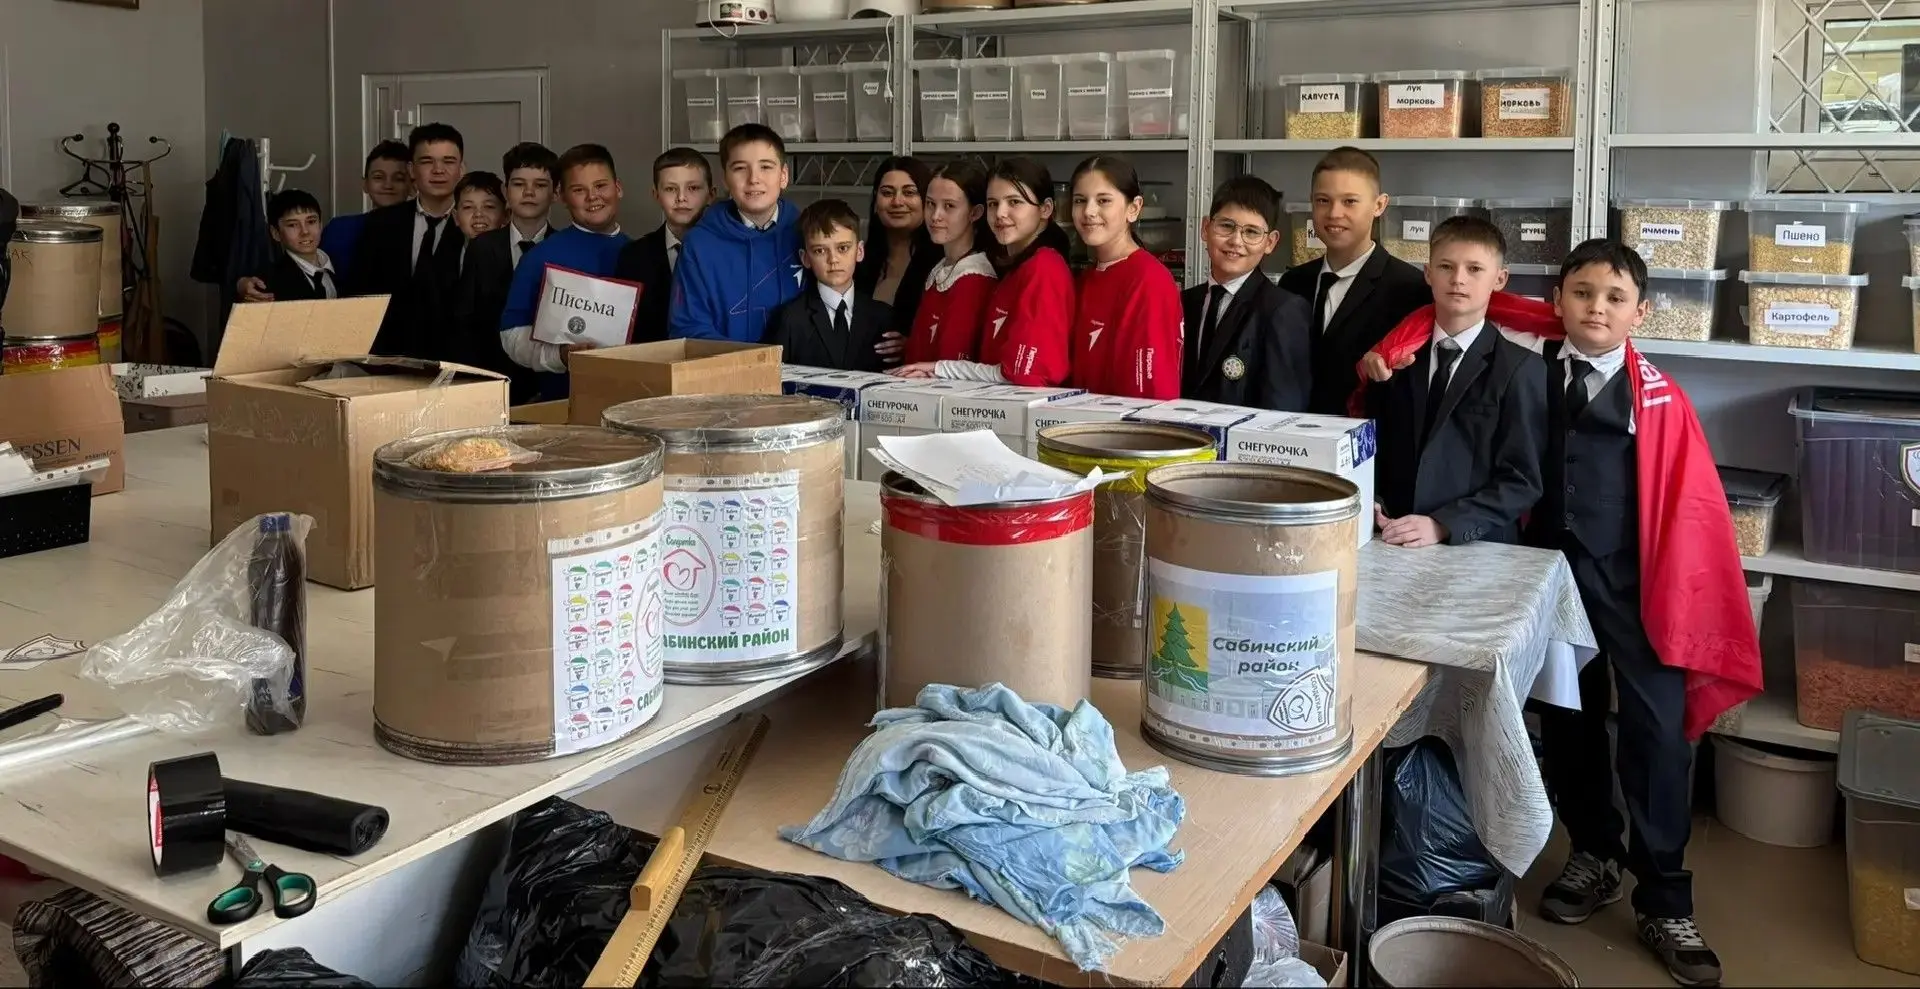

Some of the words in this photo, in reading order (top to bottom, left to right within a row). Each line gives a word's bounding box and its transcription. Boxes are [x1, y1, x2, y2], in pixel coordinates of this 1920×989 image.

[1301, 92, 1340, 101] КАПУСТА
[1396, 97, 1436, 105] морковь
[1641, 227, 1681, 236] ячмень
[1782, 229, 1820, 241] Пшено
[552, 286, 615, 317] Письма
[1771, 311, 1830, 323] Картофель
[867, 399, 919, 412] СНЕГУРОЧКА
[951, 406, 1007, 420] СНЕГУРОЧКА
[1238, 440, 1309, 458] СНЕГУРОЧКА
[742, 627, 790, 648] РАЙОН
[1213, 636, 1319, 653] Сабинский
[1238, 659, 1299, 675] район
